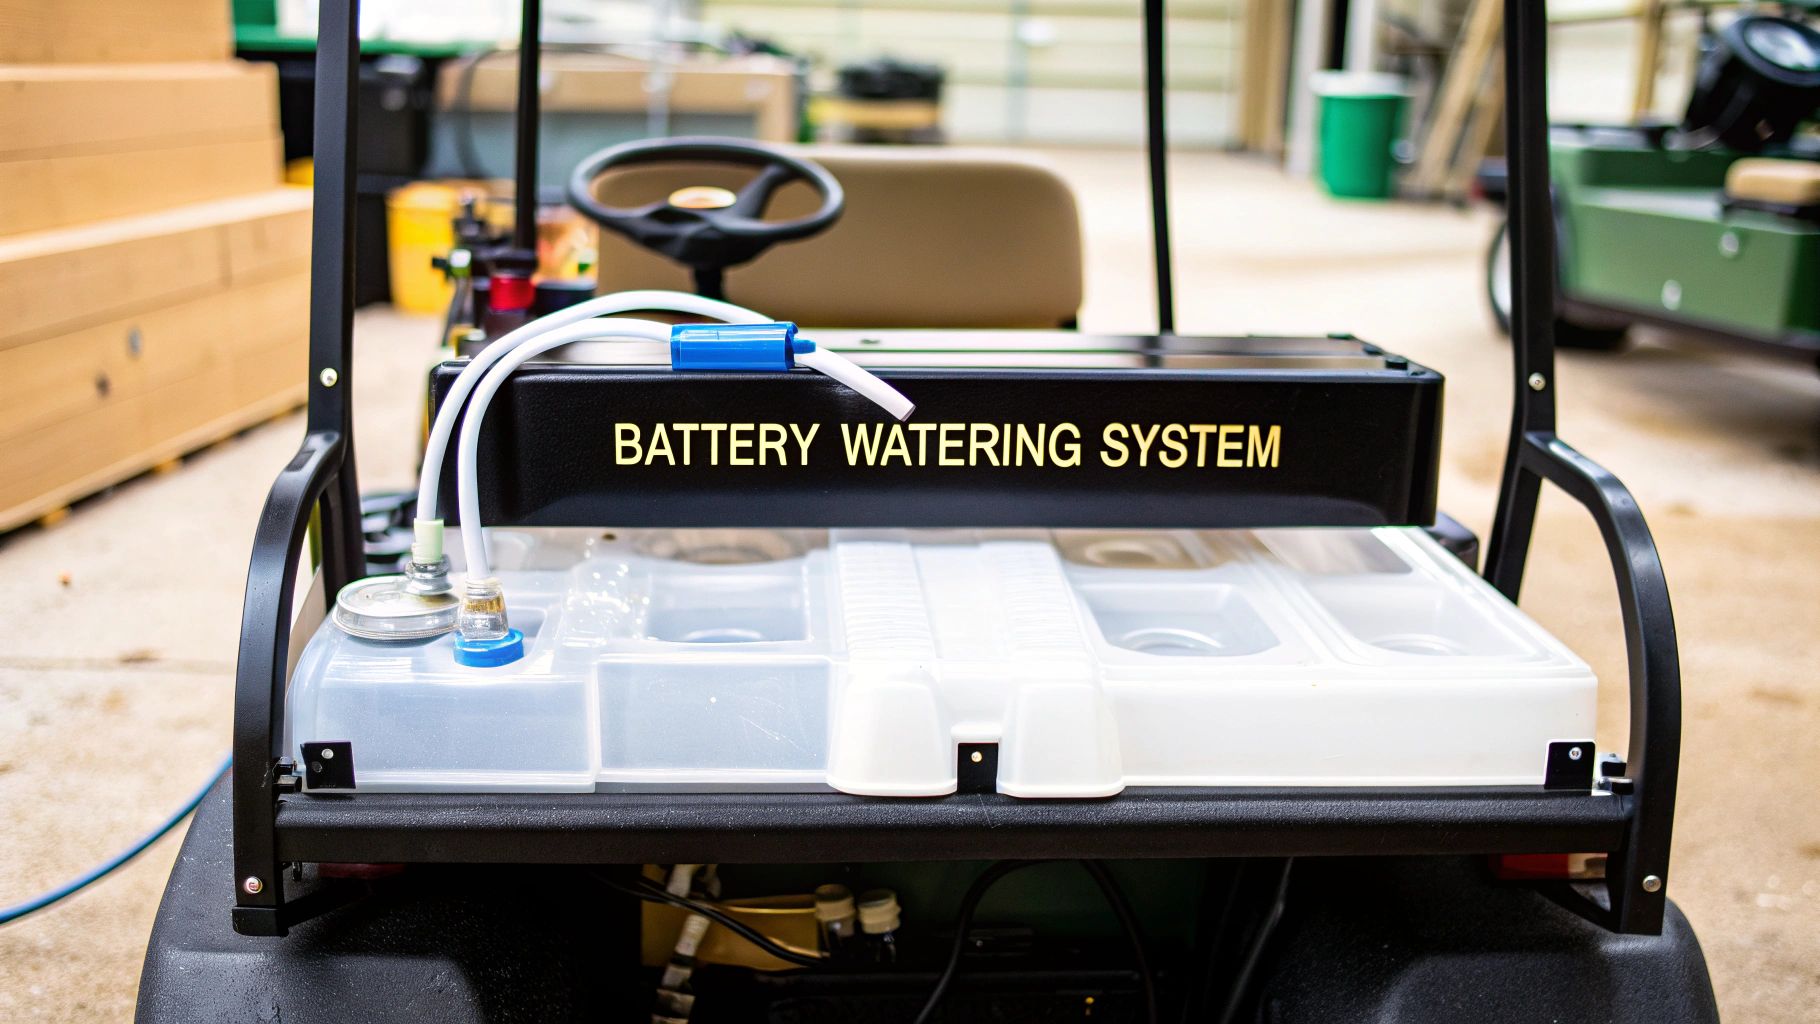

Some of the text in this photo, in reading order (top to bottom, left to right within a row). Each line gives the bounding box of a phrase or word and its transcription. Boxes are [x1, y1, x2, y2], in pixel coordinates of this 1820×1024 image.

[614, 422, 1282, 468] BATTERY WATERING SYSTEM
